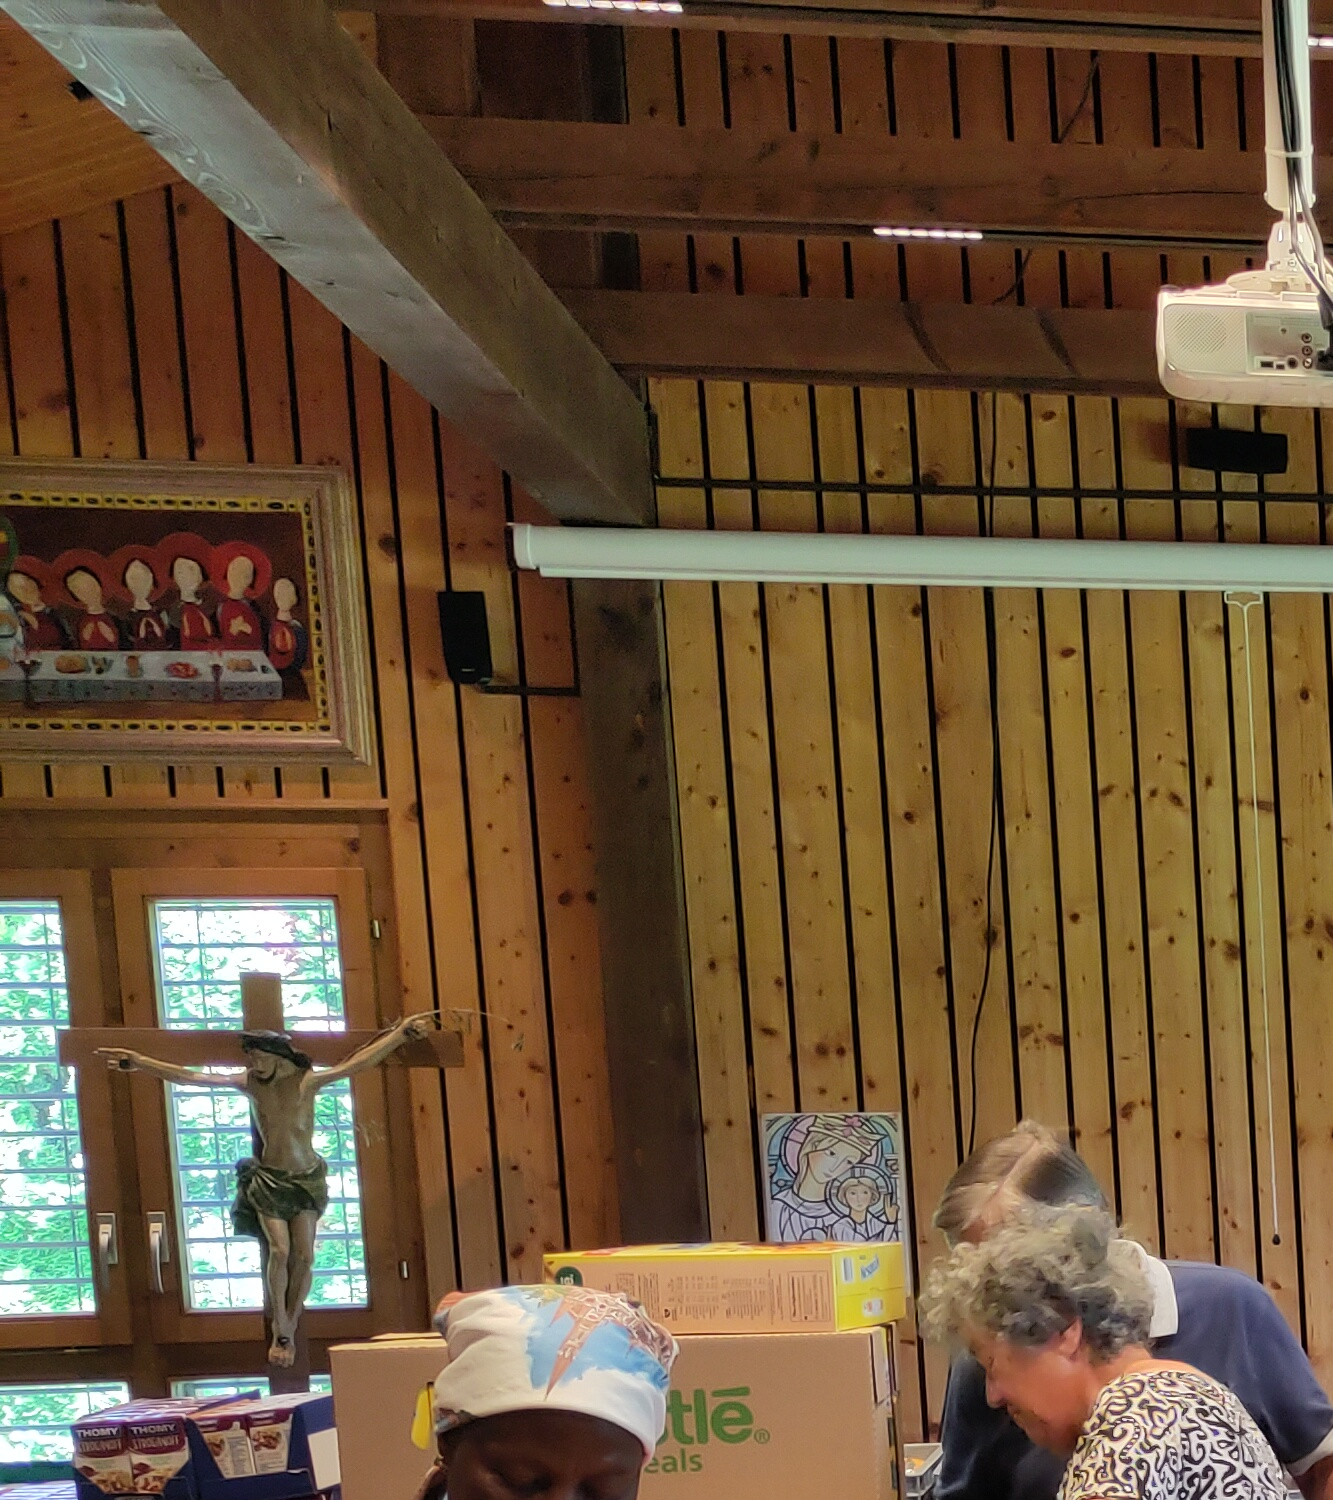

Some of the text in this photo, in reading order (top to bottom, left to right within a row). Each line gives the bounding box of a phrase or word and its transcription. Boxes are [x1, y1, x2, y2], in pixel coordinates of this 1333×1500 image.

[655, 1386, 754, 1445] tlé
[76, 1427, 119, 1438] THOMY
[130, 1423, 176, 1435] THOMY
[644, 1449, 703, 1474] eals
